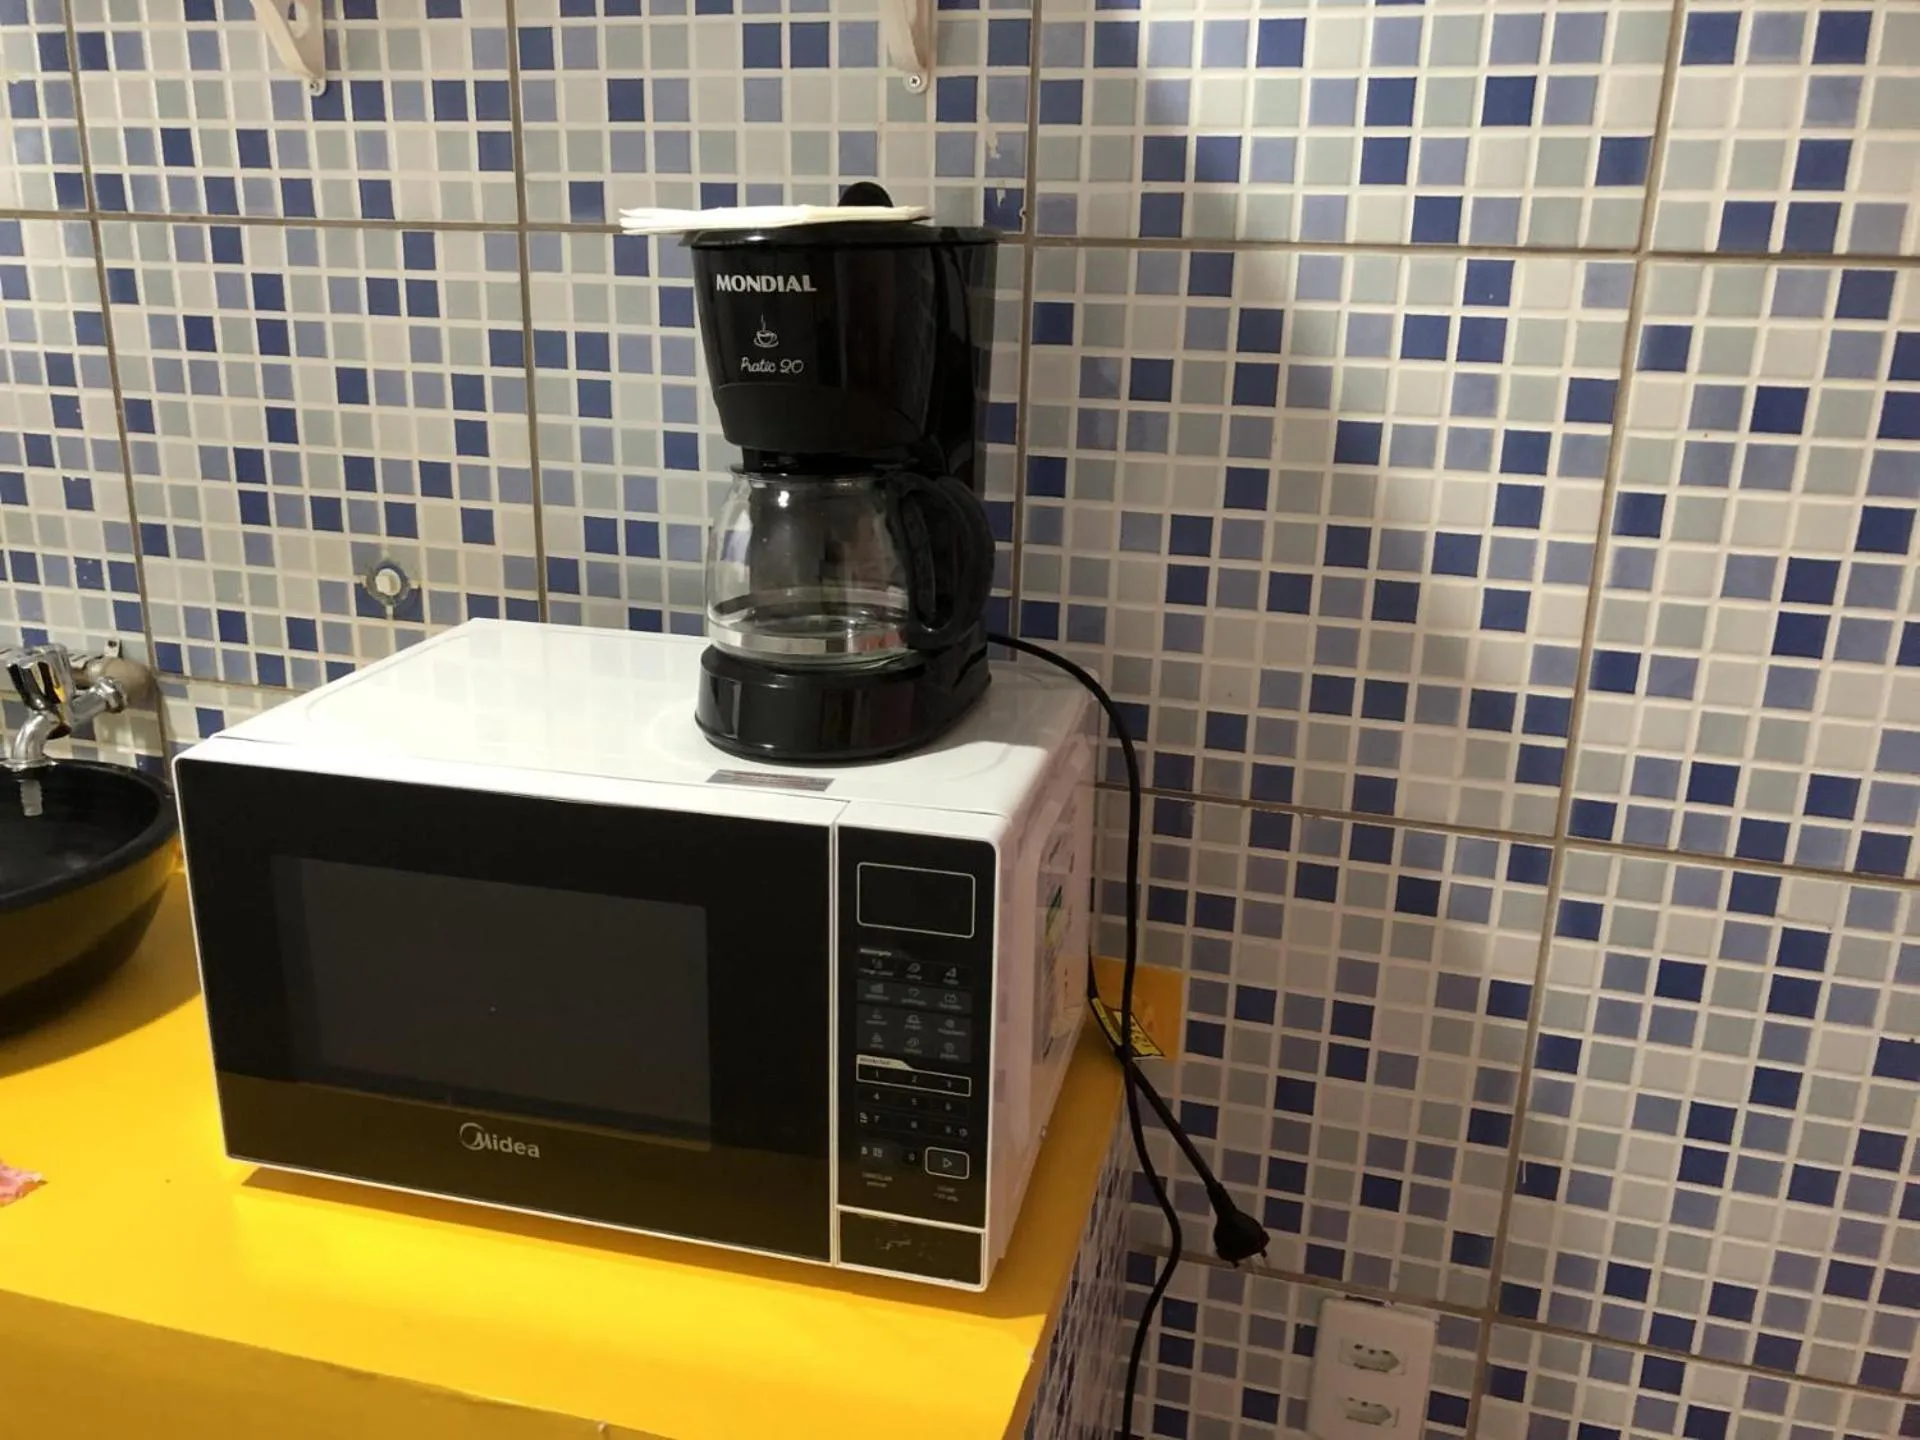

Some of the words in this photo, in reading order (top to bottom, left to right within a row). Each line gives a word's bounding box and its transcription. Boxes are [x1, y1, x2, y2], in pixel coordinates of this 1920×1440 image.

[716, 274, 817, 292] MONDIAL
[740, 356, 777, 373] Pratic
[459, 1122, 540, 1158] Midea
